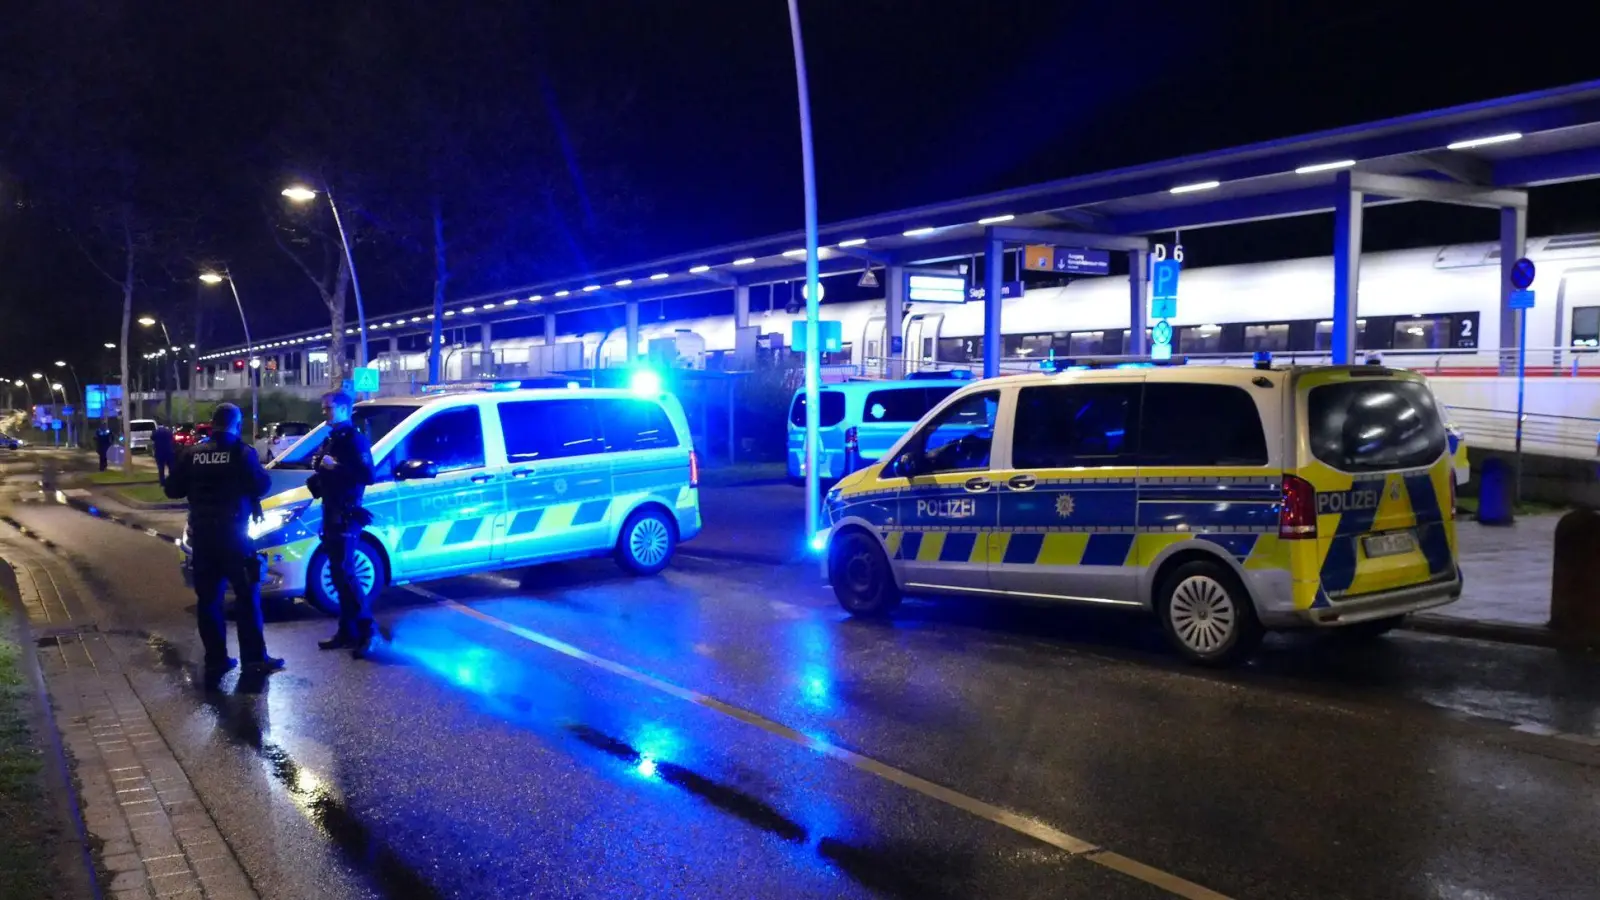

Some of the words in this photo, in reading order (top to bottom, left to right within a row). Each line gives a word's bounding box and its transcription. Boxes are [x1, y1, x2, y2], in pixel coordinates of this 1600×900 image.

[1154, 243, 1167, 262] D
[1173, 244, 1184, 263] 6
[1158, 265, 1173, 293] P
[1460, 319, 1473, 337] 2
[966, 340, 973, 353] 2
[192, 451, 231, 464] POLIZEI
[917, 499, 976, 518] POLIZEI
[1318, 490, 1377, 512] POLIZEI
